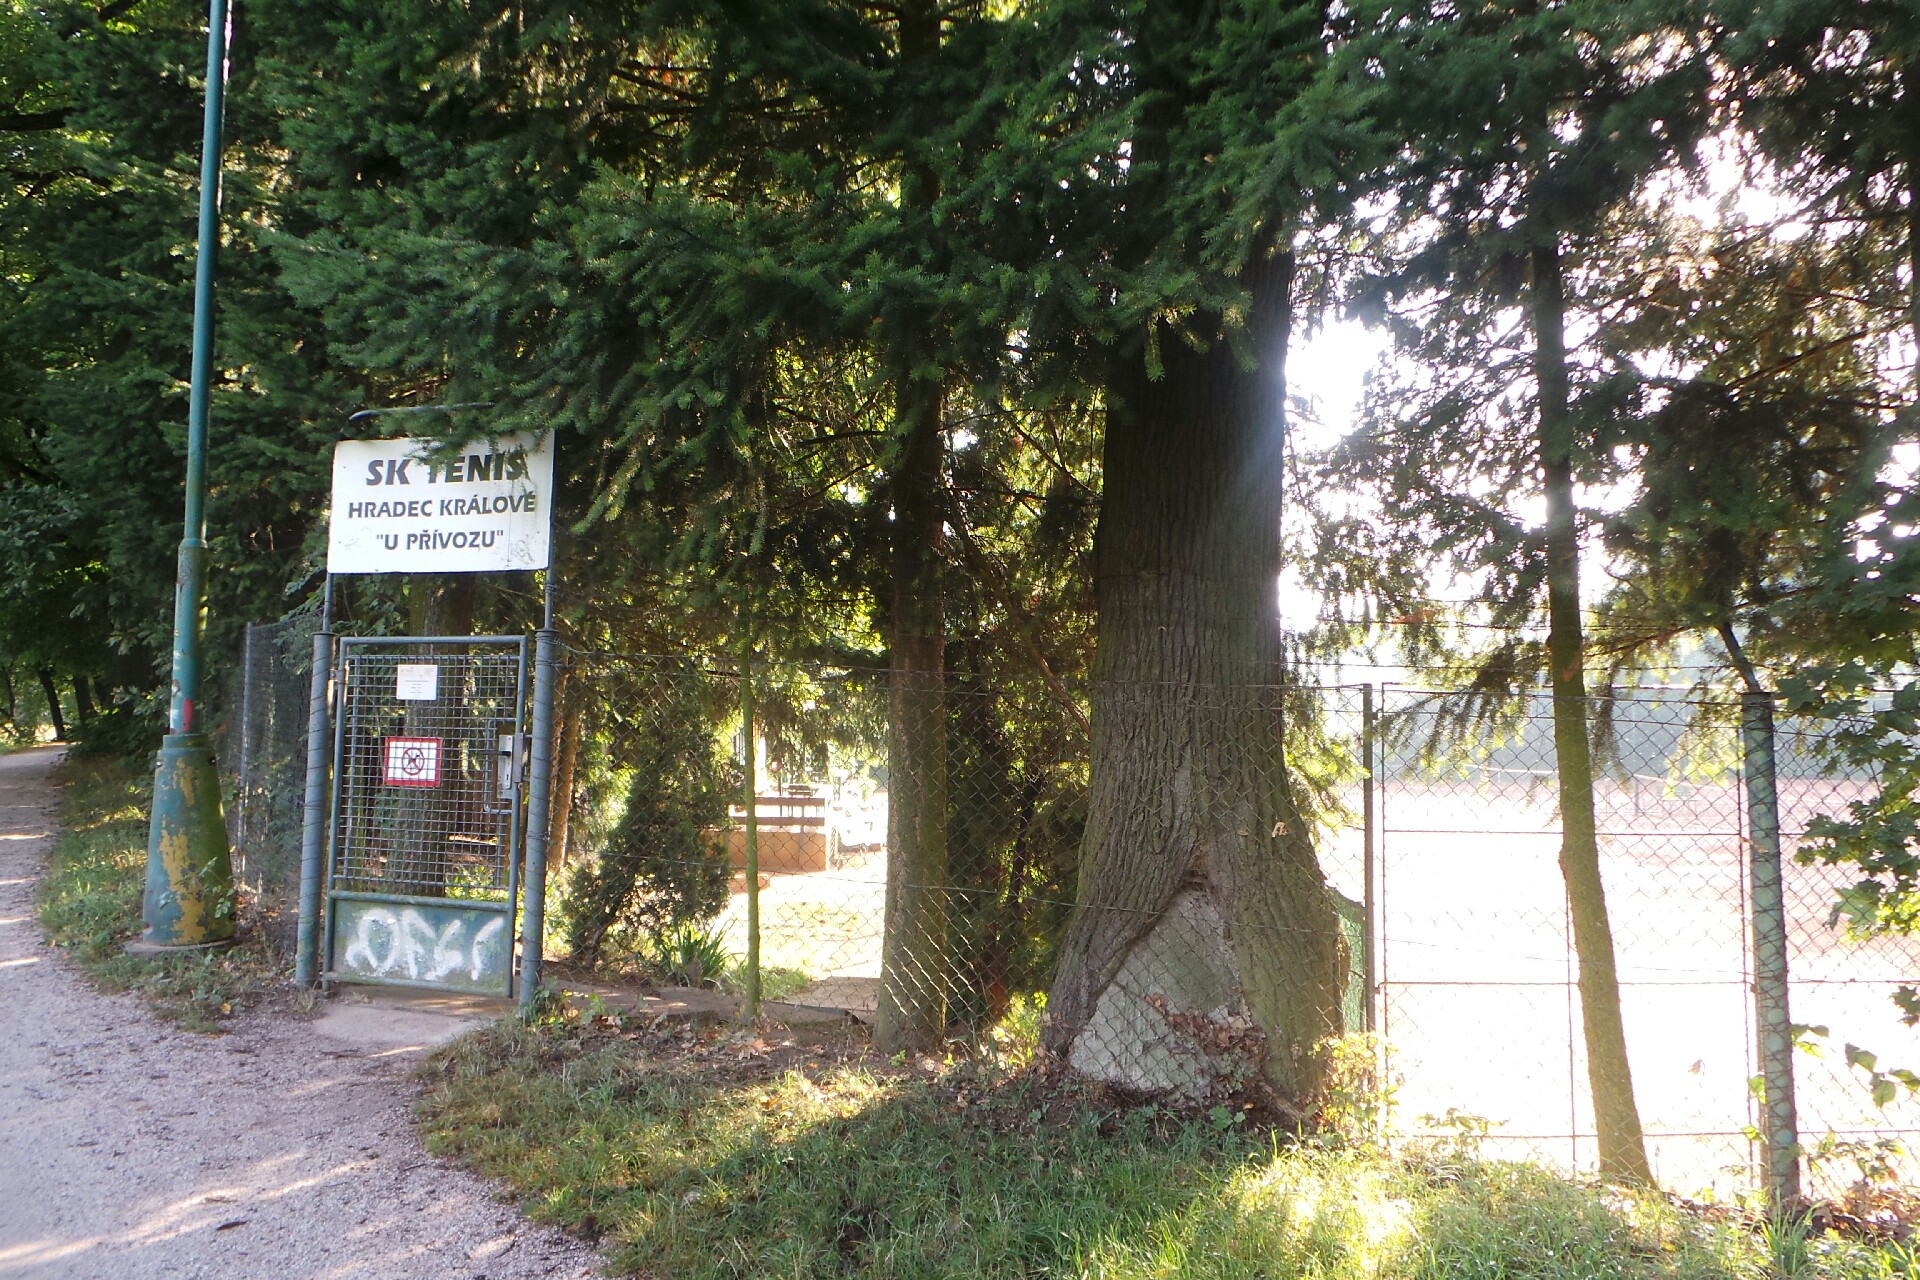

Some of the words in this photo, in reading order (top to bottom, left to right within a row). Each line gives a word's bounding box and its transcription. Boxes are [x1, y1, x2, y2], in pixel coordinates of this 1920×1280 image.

[365, 458, 412, 486] SK
[347, 499, 433, 519] HRADEC
[439, 491, 536, 516] KRÁLOVÉ
[376, 534, 398, 551] "U
[406, 529, 504, 551] PŘÍVOZU"
